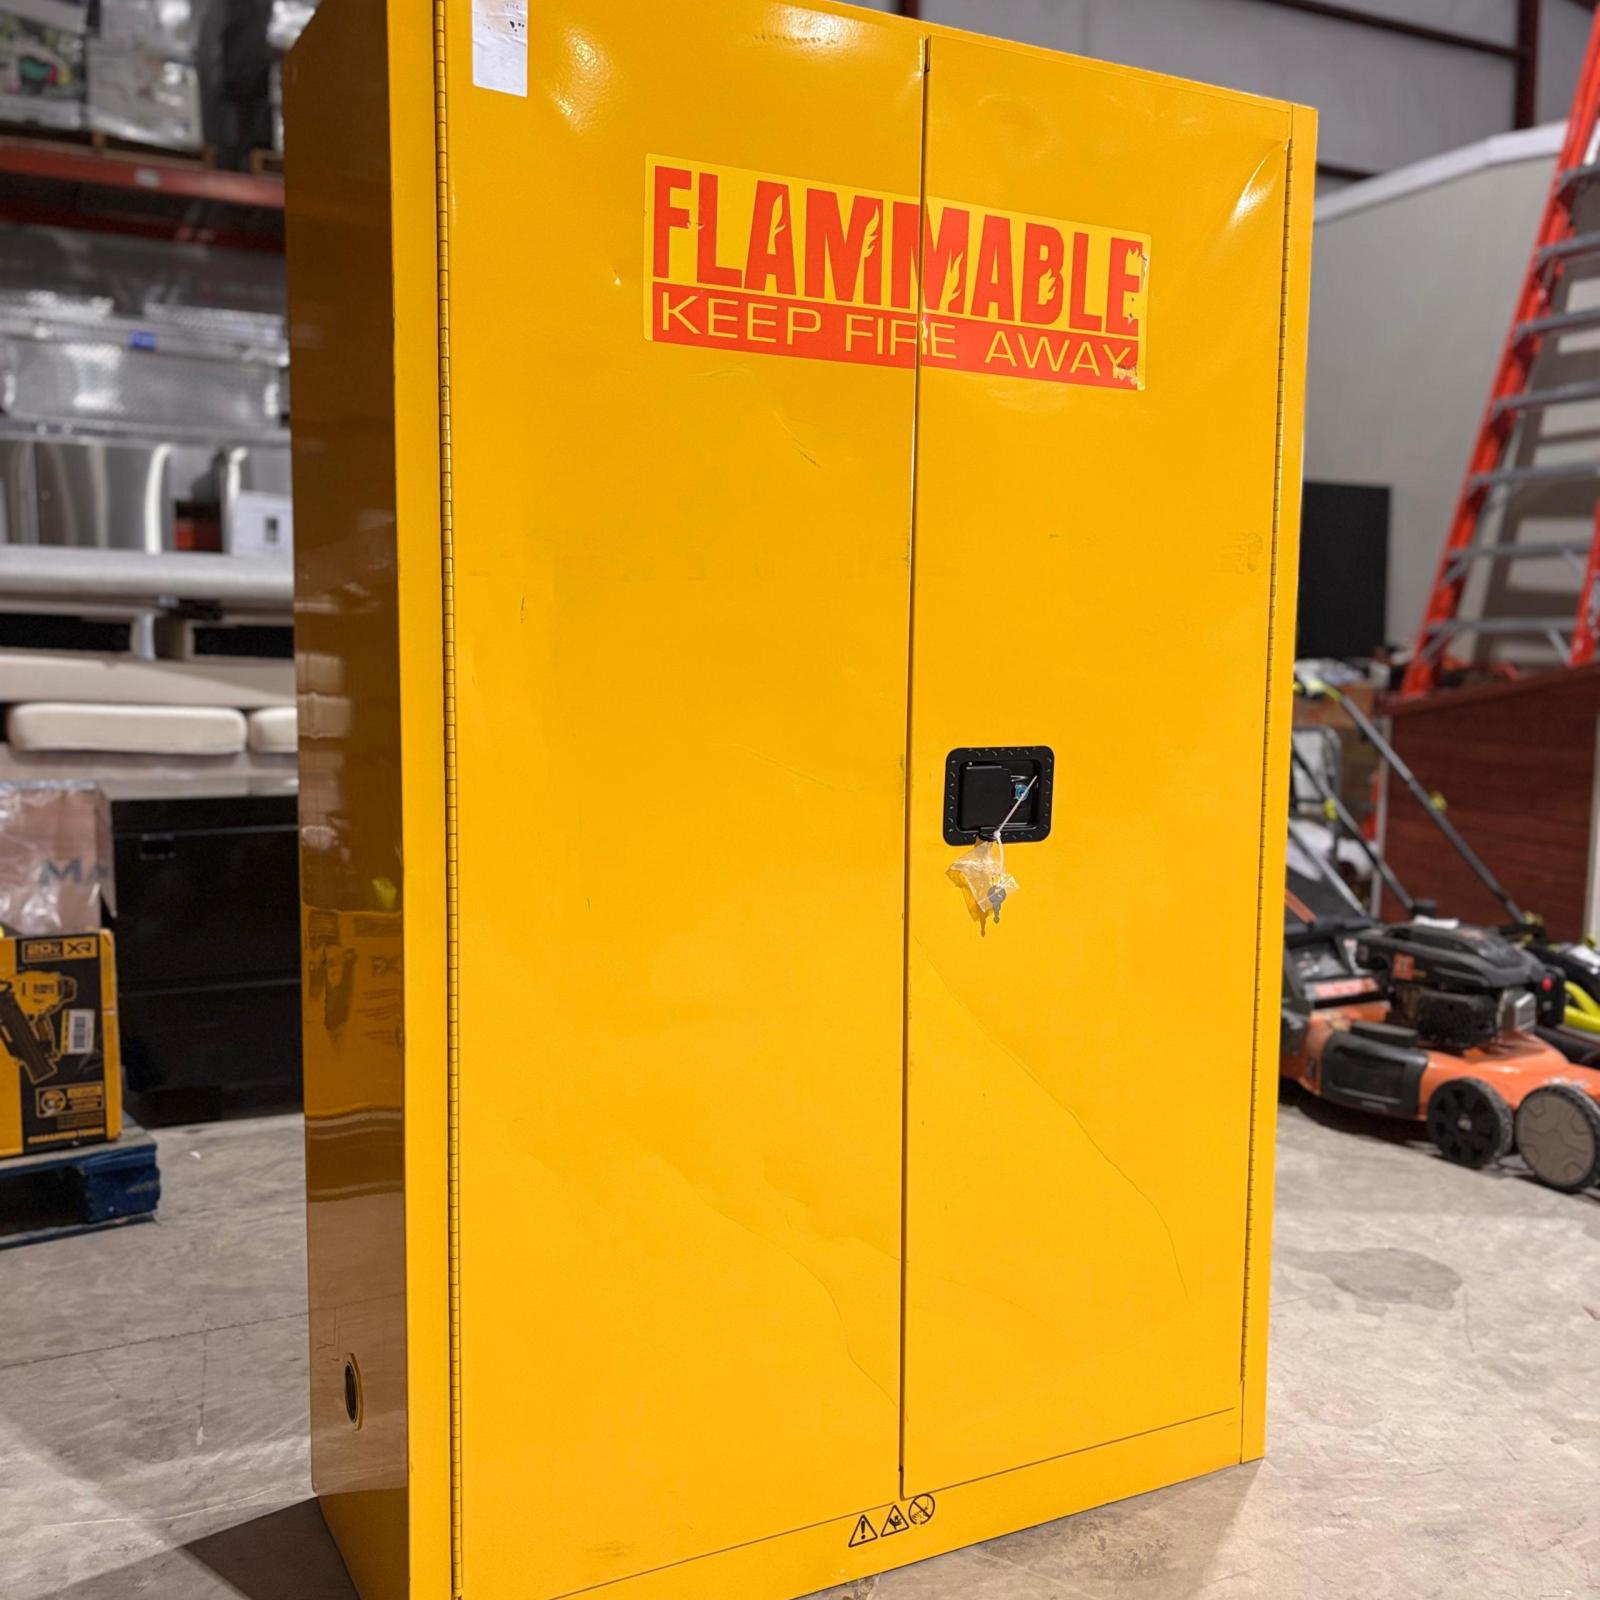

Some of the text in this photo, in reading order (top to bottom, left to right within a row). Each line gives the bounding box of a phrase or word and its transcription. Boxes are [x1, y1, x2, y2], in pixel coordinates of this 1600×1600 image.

[653, 165, 1143, 337] FLAMMABLE
[662, 292, 1131, 379] KEEP FIRE AWAY
